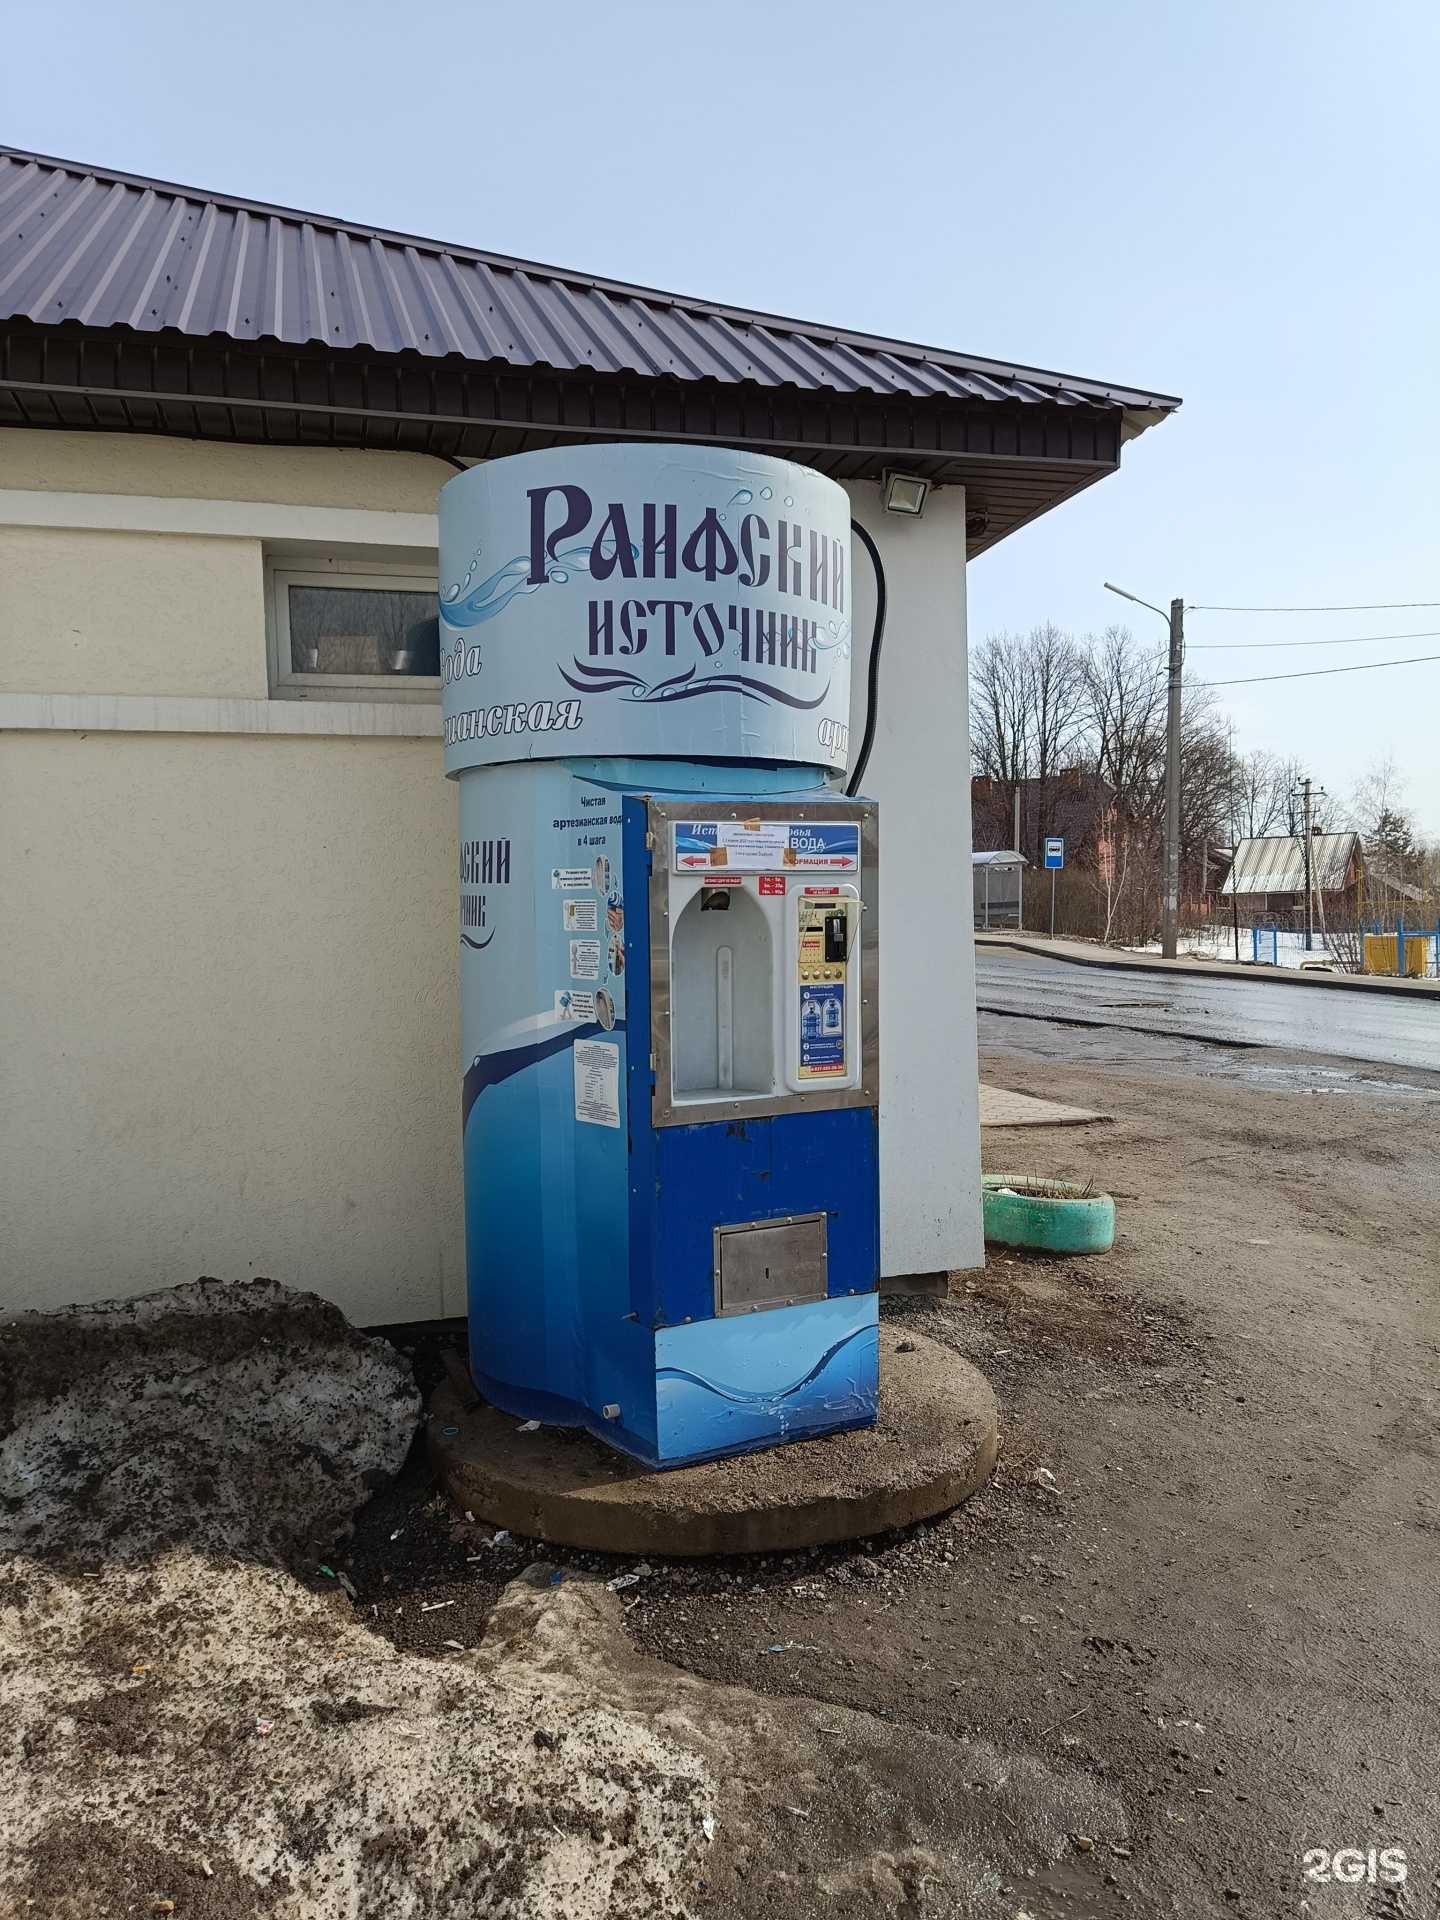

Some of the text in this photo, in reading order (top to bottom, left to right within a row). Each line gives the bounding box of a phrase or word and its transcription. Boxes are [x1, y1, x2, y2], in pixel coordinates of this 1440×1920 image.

[588, 599, 817, 674] ИСТОЧНИК
[580, 796, 606, 807] Чистая
[552, 817, 608, 830] артезианская
[583, 835, 588, 845] 4
[589, 837, 606, 846] шага
[790, 837, 826, 851] ВОДА
